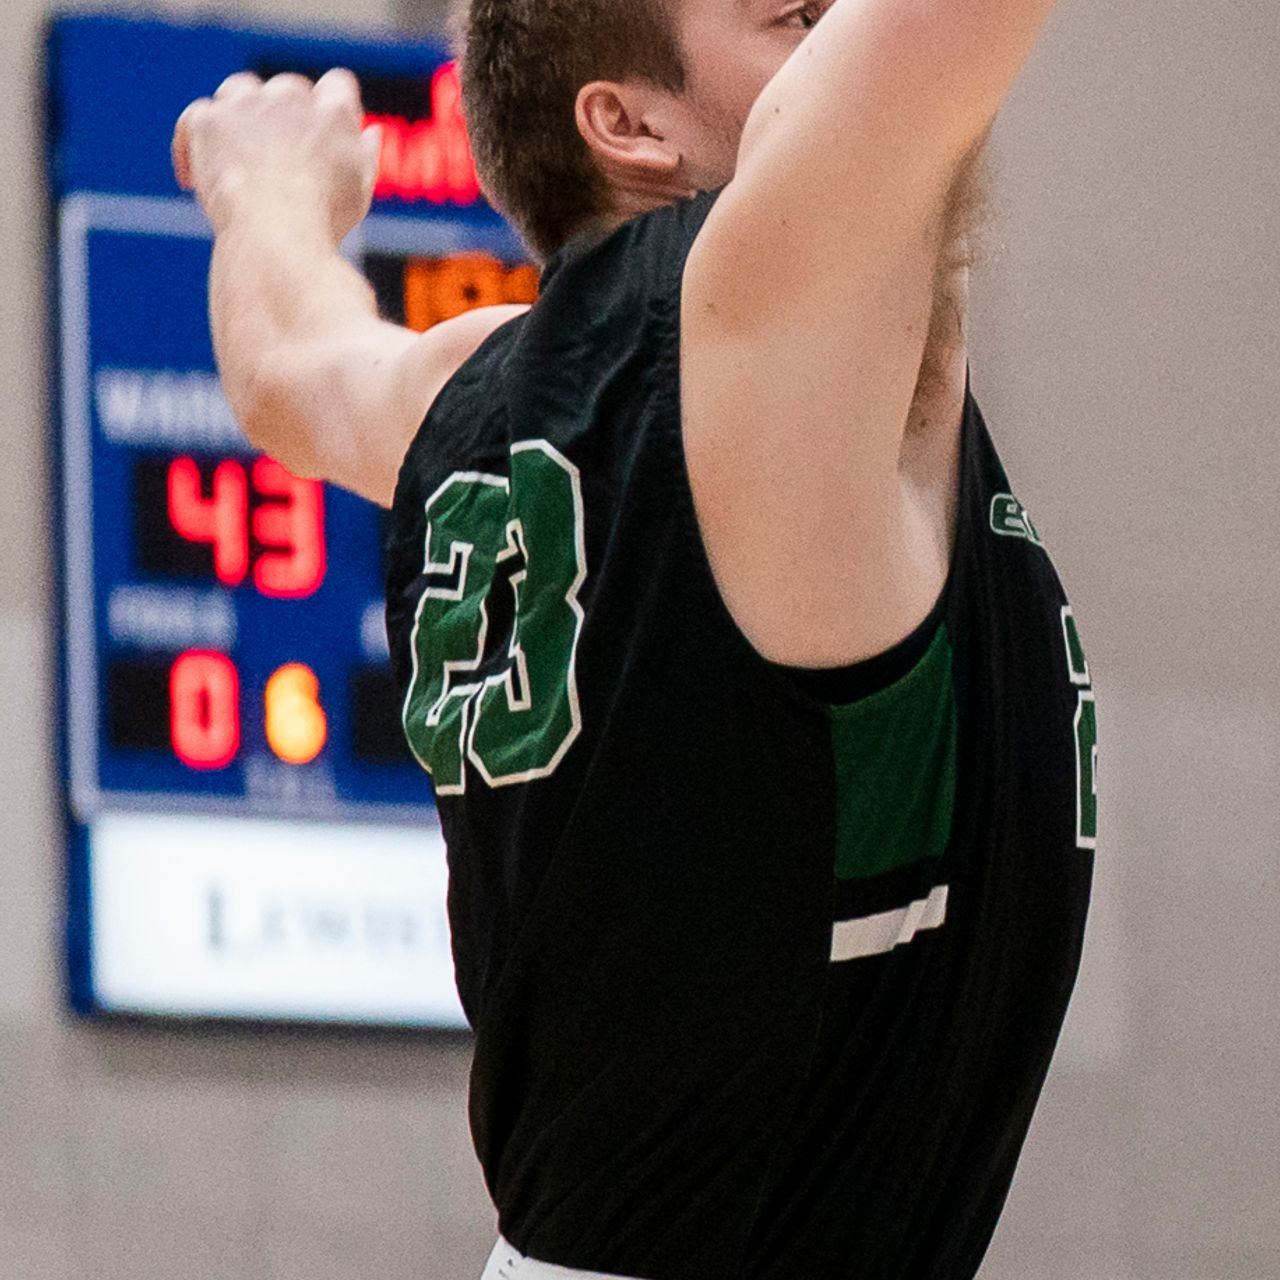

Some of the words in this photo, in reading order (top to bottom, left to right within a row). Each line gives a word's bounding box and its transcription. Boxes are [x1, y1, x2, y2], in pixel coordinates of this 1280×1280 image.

[166, 453, 327, 599] 43
[402, 438, 588, 795] 23
[168, 647, 241, 771] 0
[263, 662, 328, 765] 6
